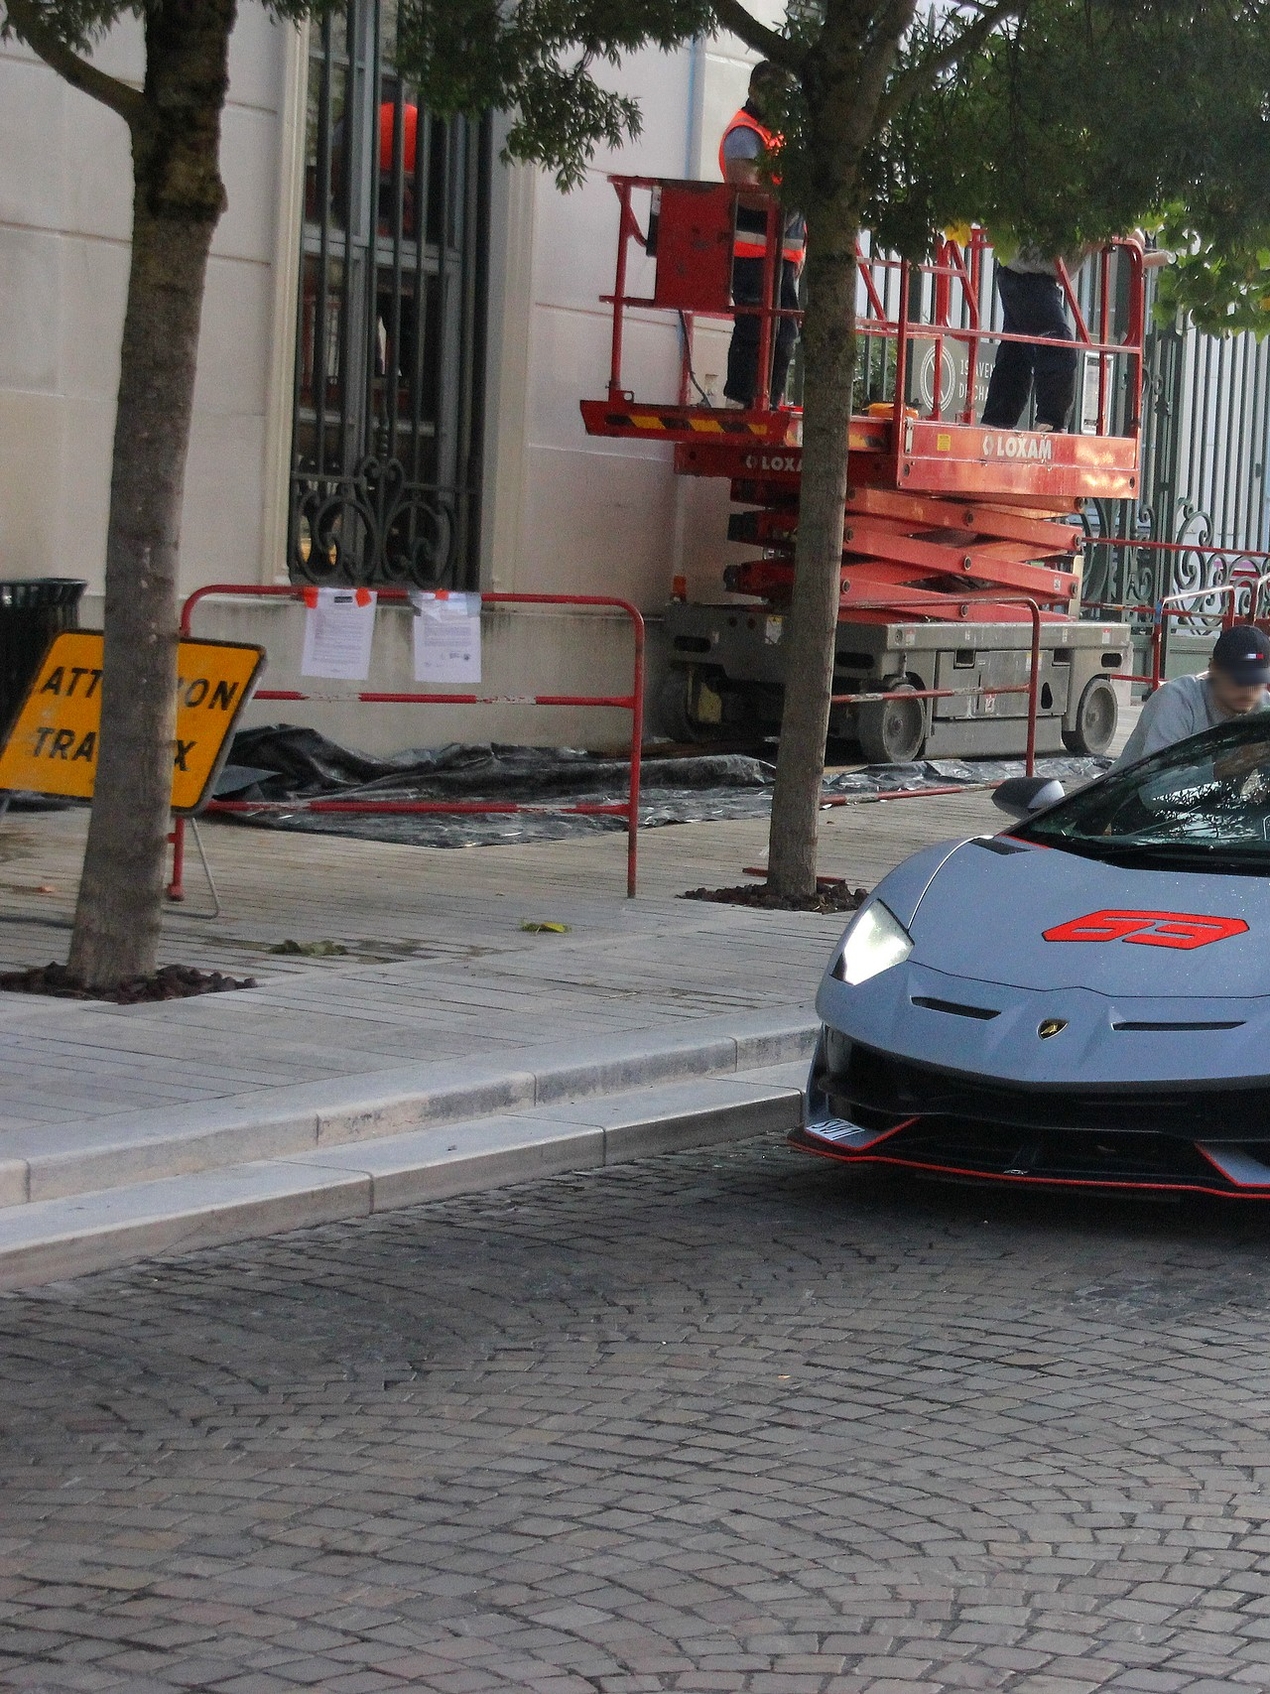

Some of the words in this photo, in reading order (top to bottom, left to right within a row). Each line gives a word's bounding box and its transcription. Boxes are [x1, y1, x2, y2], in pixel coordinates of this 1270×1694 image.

[761, 455, 802, 472] LOX
[996, 436, 1052, 460] LOXAM
[40, 666, 240, 711] ATTON
[33, 726, 197, 771] TRAX
[1041, 909, 1251, 950] 63
